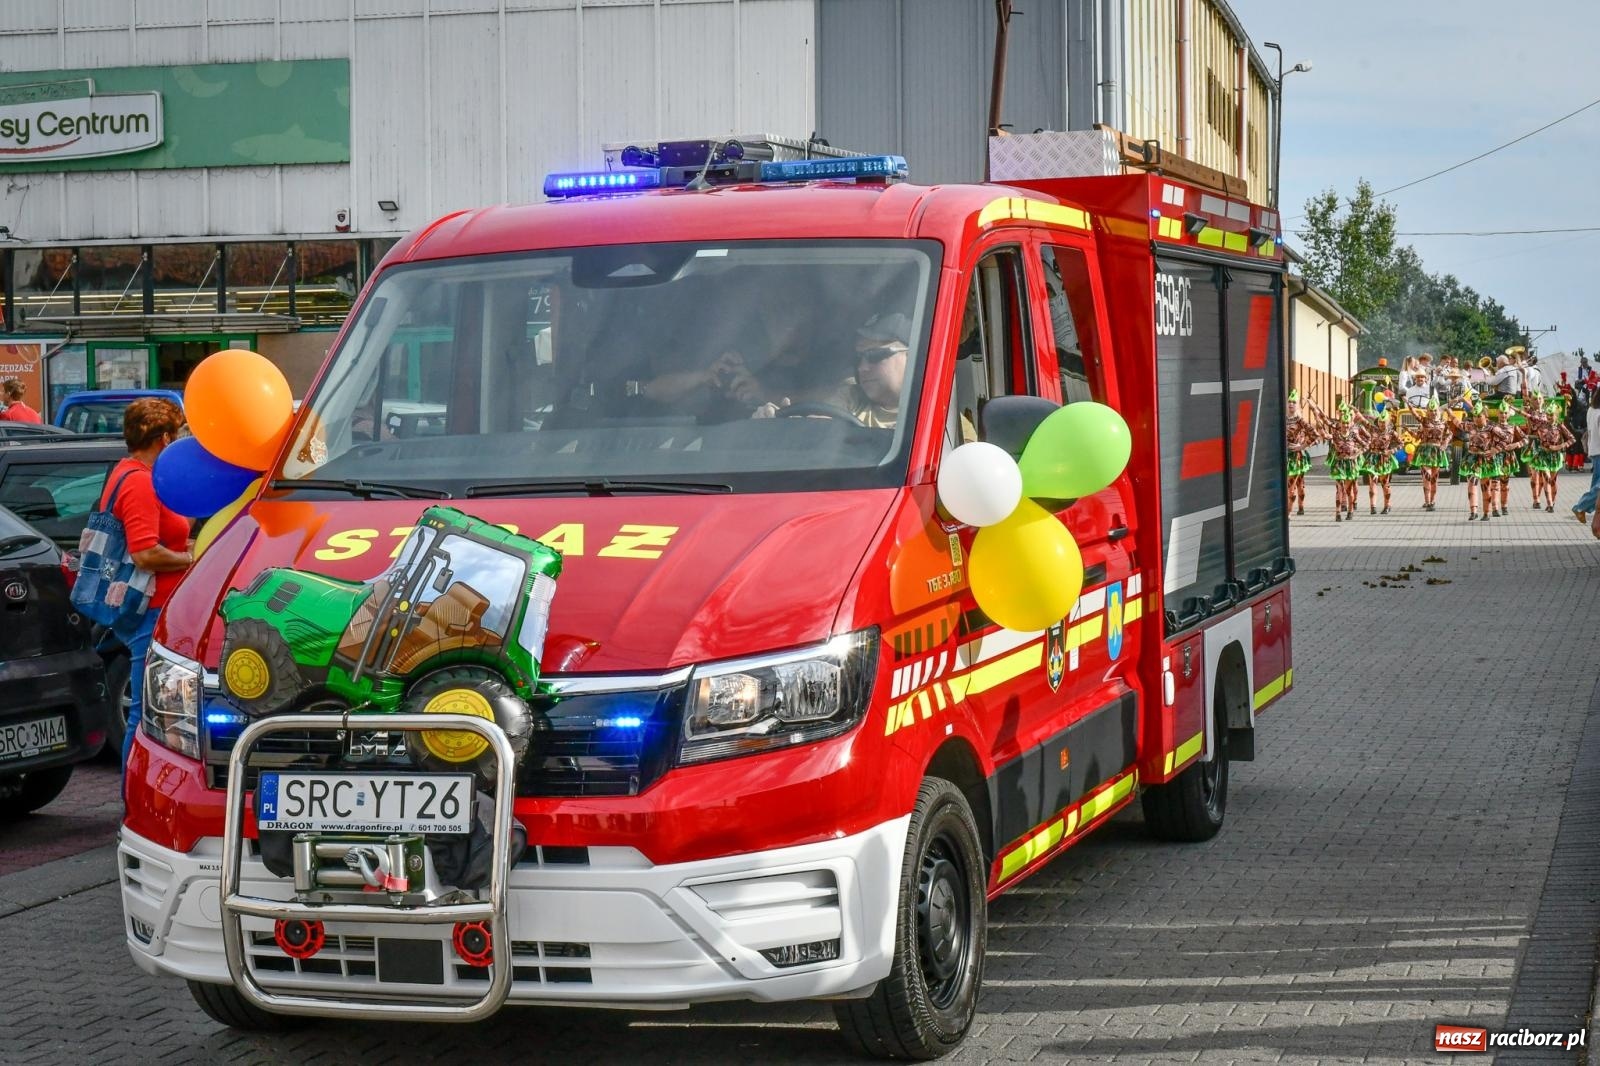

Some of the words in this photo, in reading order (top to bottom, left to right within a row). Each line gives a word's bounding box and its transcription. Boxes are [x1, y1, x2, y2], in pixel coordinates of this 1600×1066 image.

[0, 118, 30, 145] sy
[37, 111, 149, 137] Centrum
[8, 584, 25, 597] KIA
[30, 717, 65, 746] 3MA4
[262, 802, 276, 814] PL
[285, 779, 353, 818] SRC
[369, 780, 460, 819] YT26
[266, 821, 314, 830] DRAGON
[320, 823, 403, 833] www.dragonfire.pl
[433, 824, 447, 832] 700
